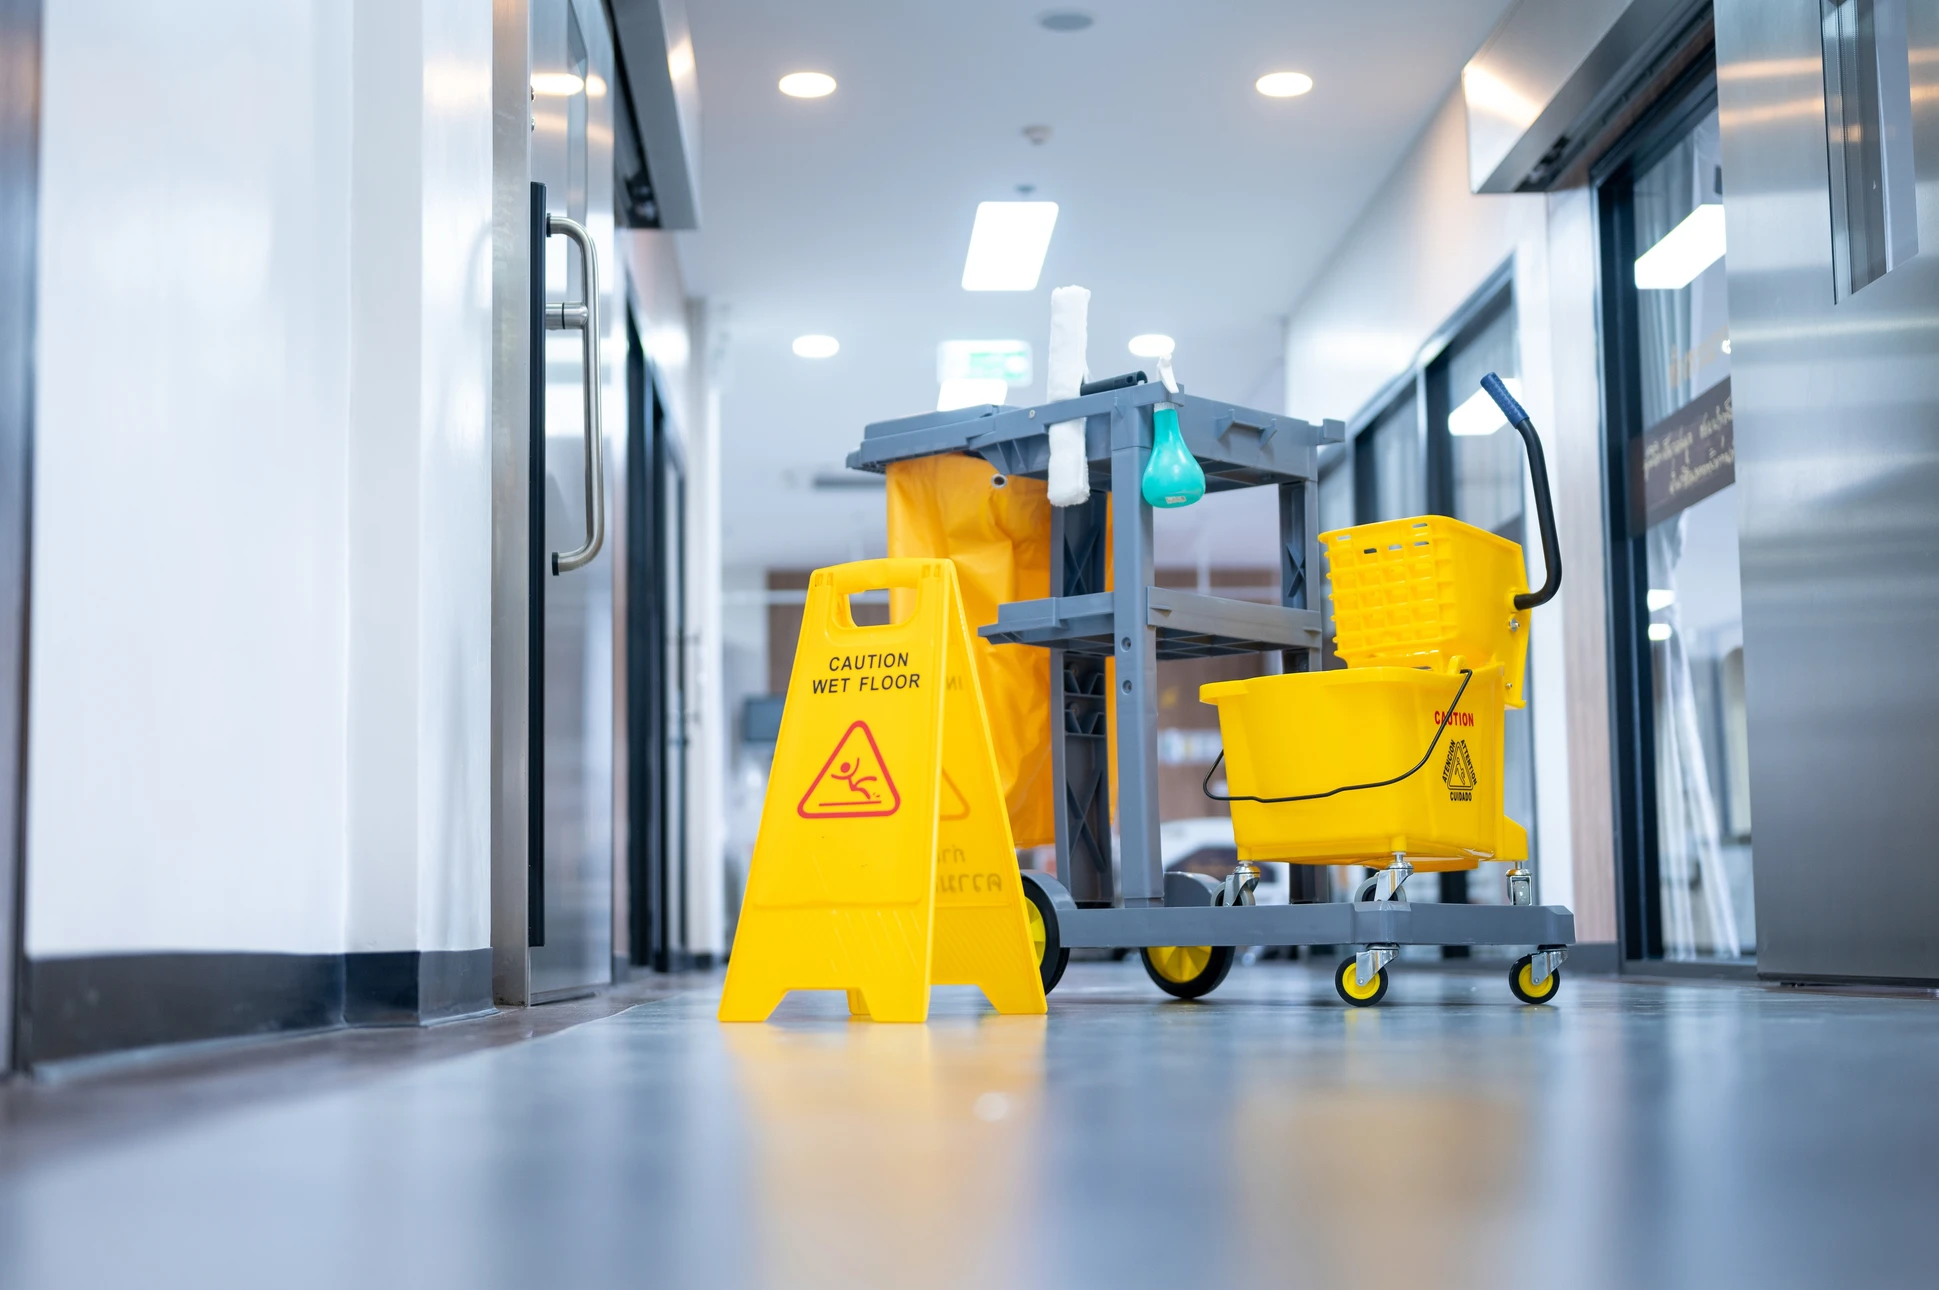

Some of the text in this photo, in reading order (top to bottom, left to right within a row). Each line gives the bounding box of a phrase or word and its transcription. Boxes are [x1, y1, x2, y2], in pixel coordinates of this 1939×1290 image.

[829, 652, 909, 672] CAUTION
[812, 673, 921, 694] WET FLOOR
[1442, 739, 1456, 783] ATENCION
[1460, 739, 1477, 785] ATTENTION
[1450, 791, 1472, 801] CUIDADO
